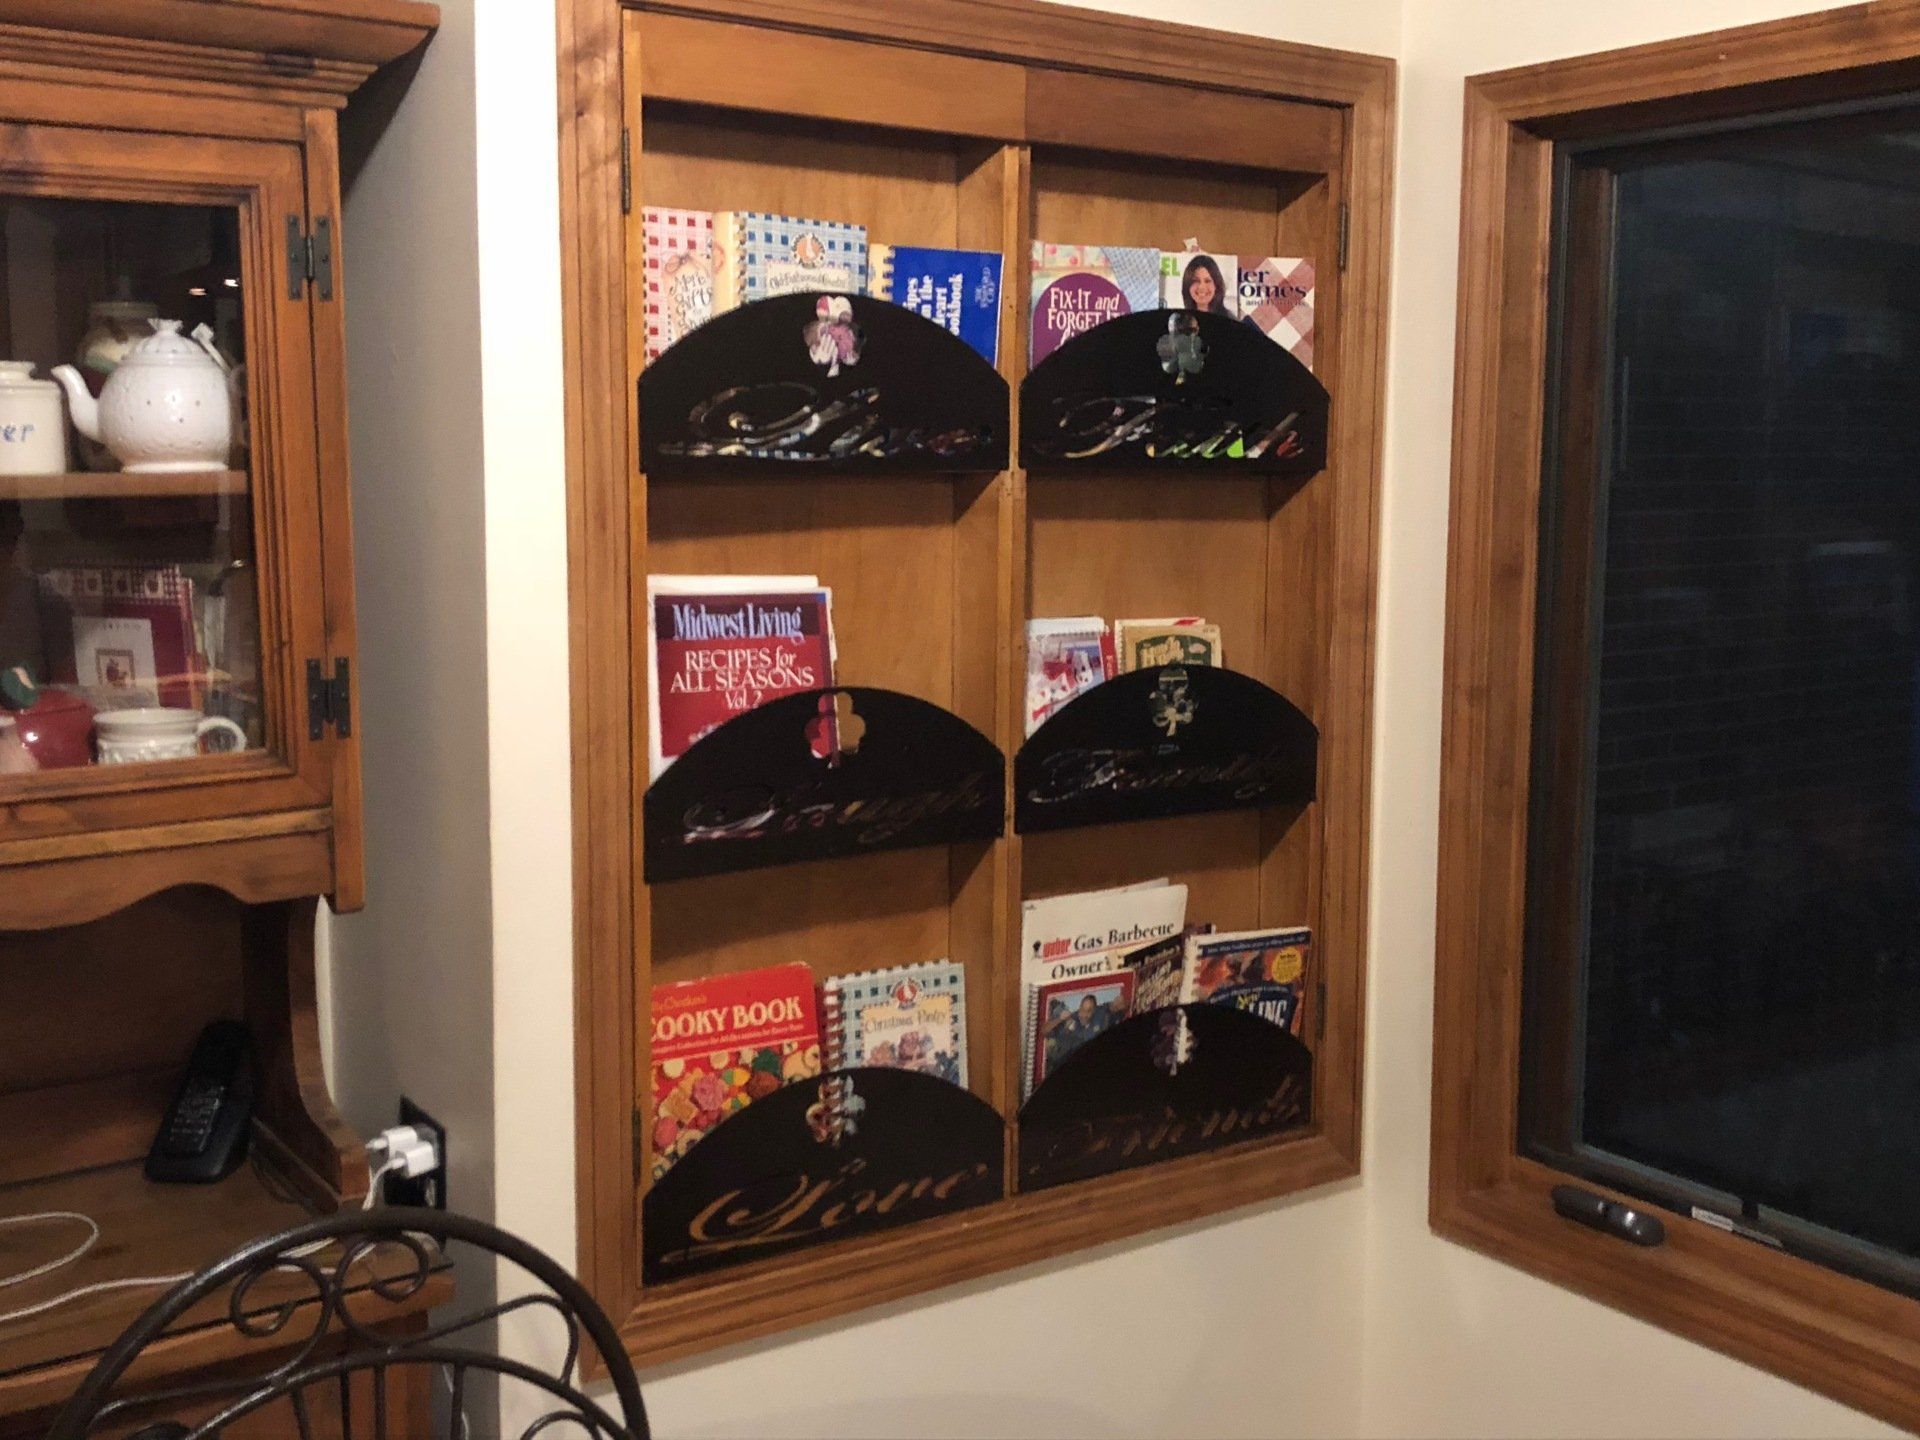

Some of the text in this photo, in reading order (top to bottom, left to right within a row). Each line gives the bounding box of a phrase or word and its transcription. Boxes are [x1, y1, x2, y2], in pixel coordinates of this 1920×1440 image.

[1050, 287, 1120, 310] FIX-IT and
[1048, 308, 1102, 333] FORGET
[672, 602, 805, 646] Midwest Living
[685, 645, 797, 672] RECIPES for
[670, 666, 815, 693] ALL SEASONS
[1074, 934, 1103, 951] Gas
[1108, 922, 1175, 946] Barbecue
[732, 995, 805, 1029] BOOK
